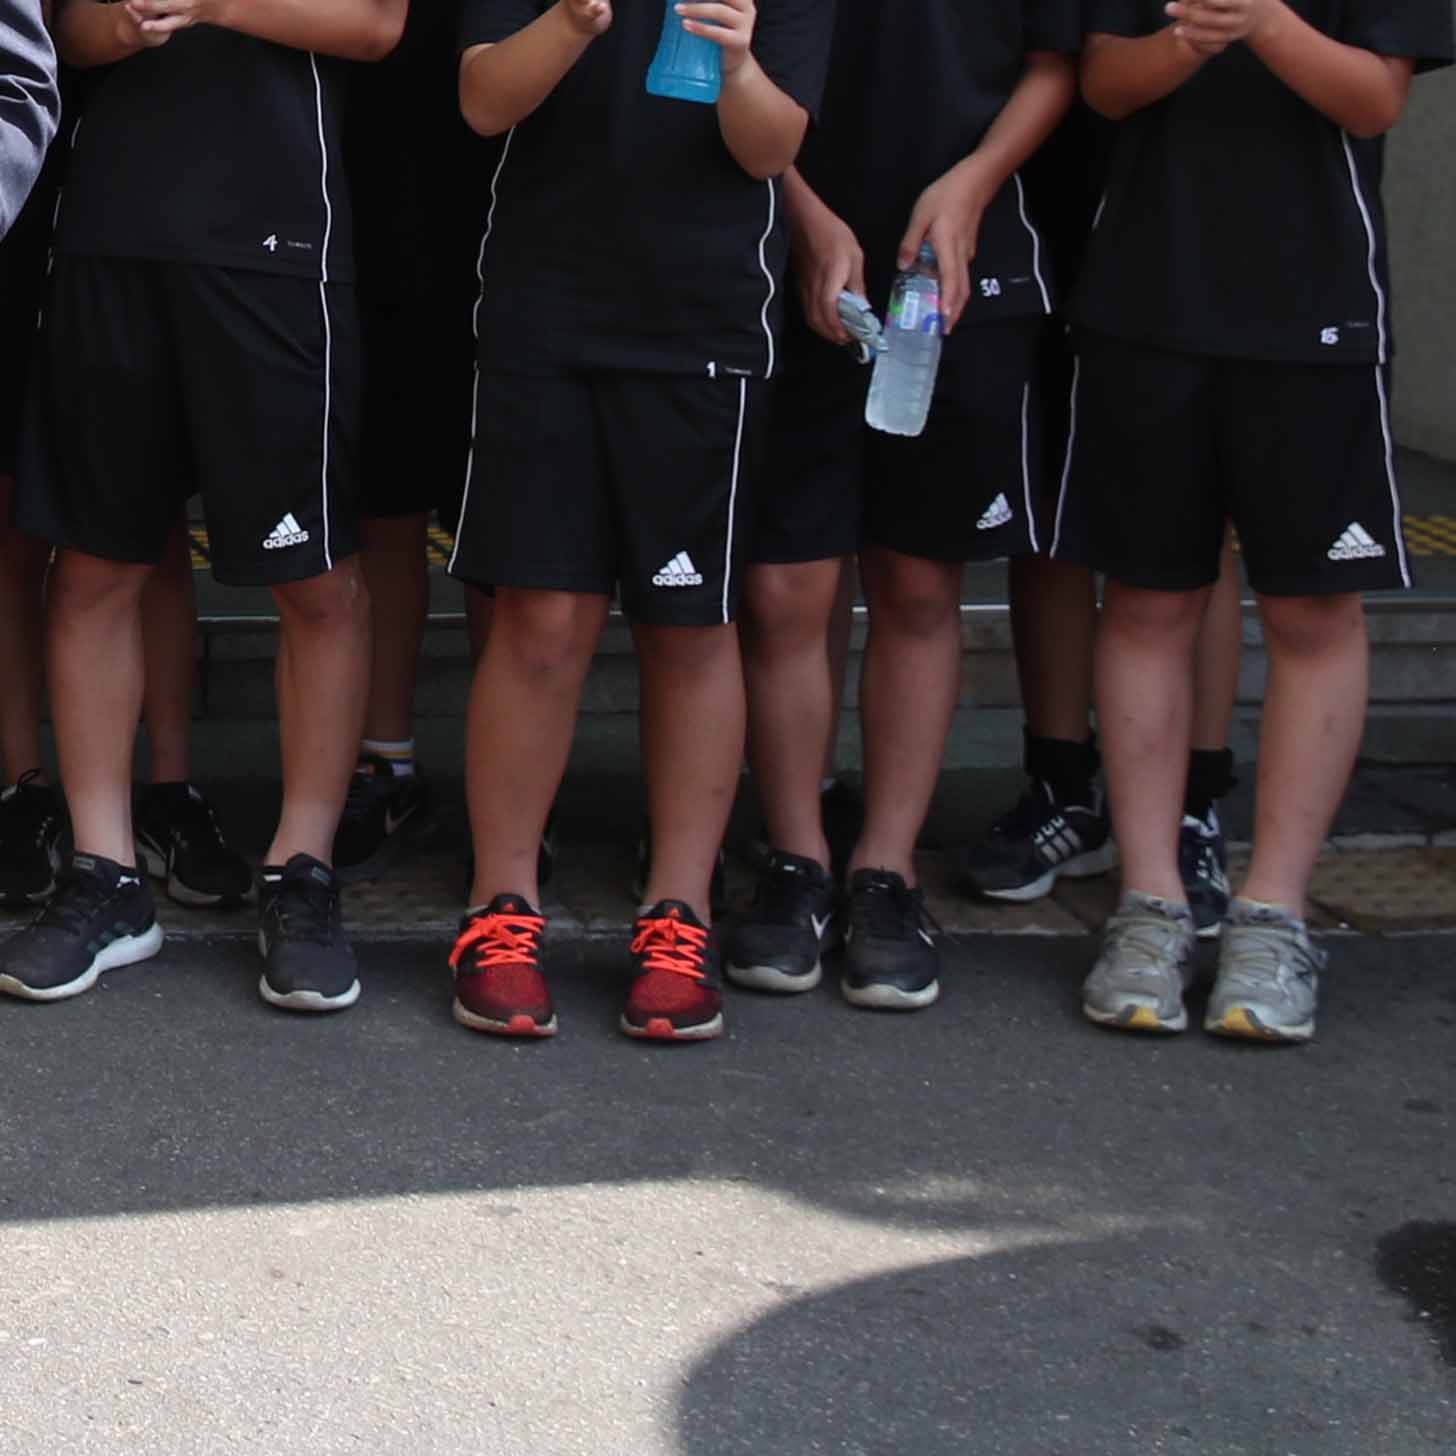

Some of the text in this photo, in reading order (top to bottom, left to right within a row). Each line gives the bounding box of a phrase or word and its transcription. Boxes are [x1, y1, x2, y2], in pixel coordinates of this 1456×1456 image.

[262, 232, 278, 253] 4
[262, 529, 311, 550] adidas
[1327, 543, 1386, 561] adidas
[651, 572, 703, 587] adidas
